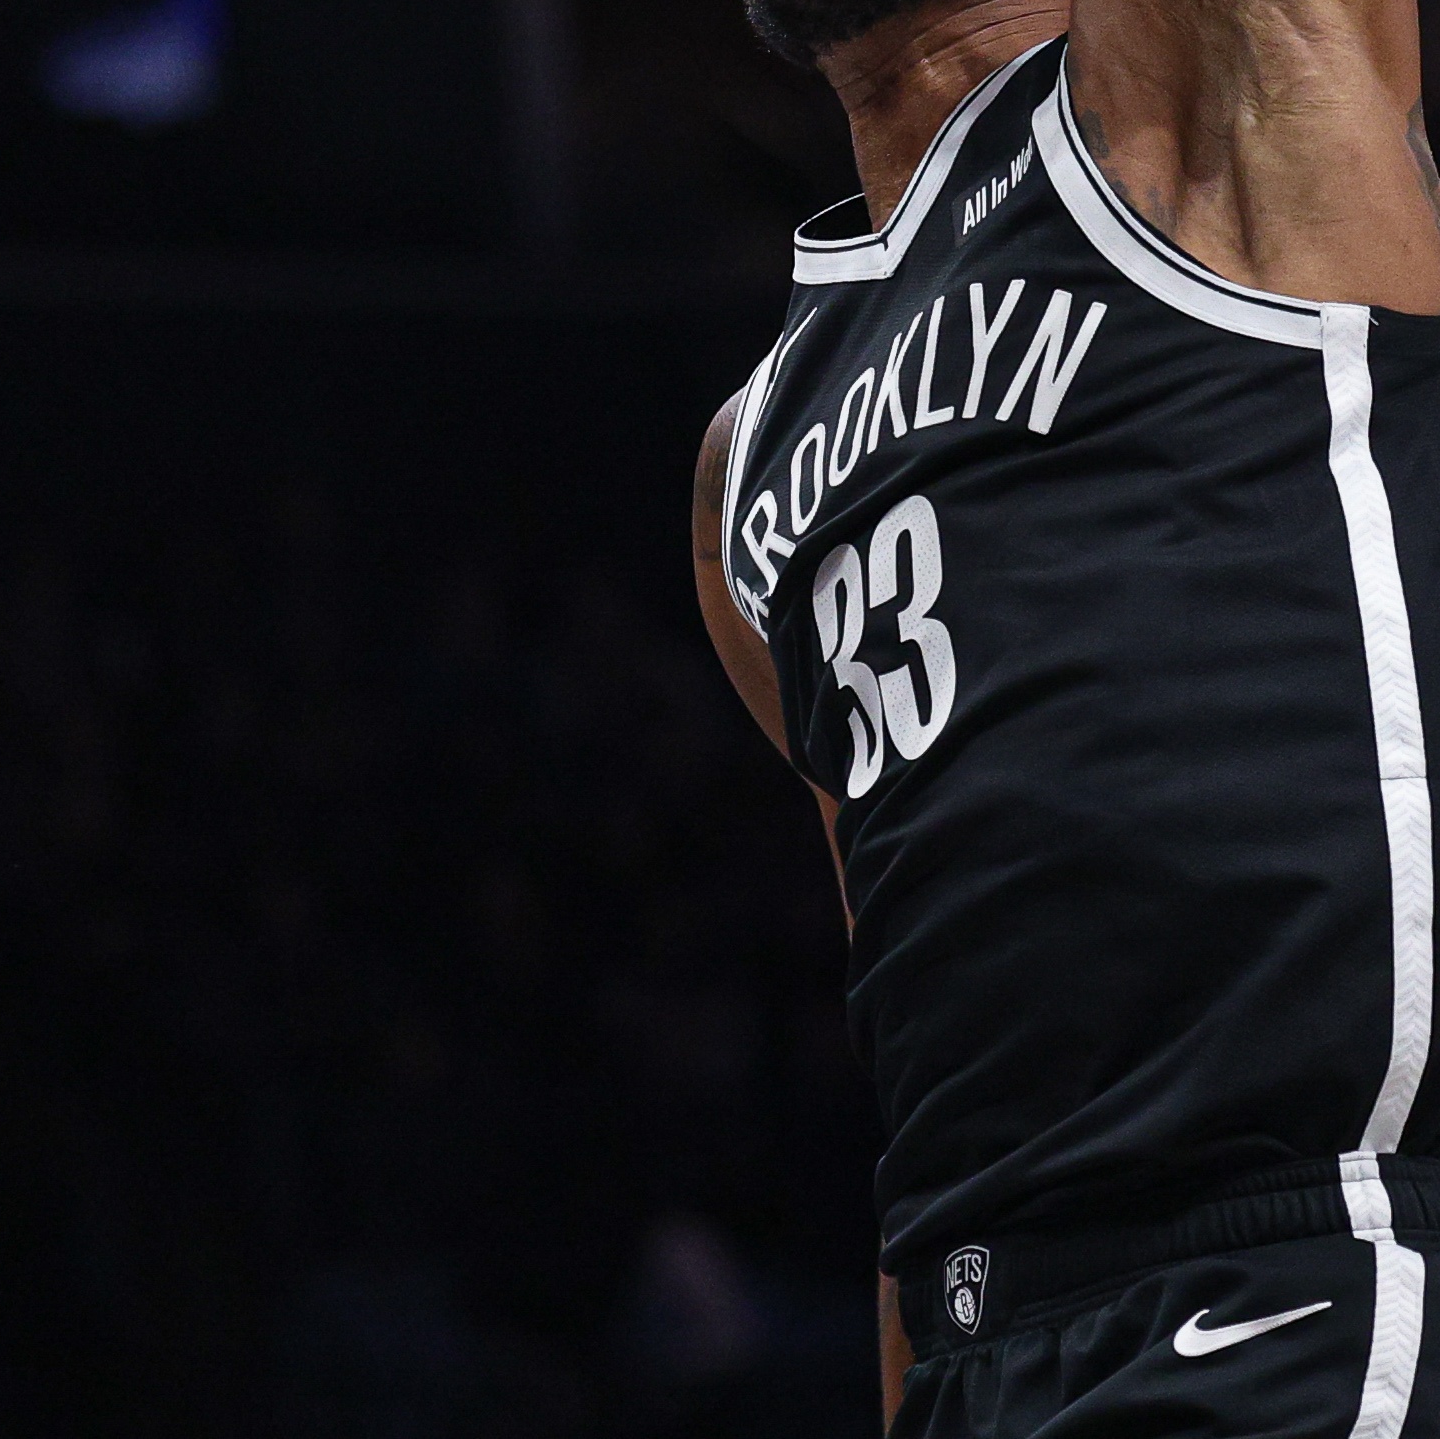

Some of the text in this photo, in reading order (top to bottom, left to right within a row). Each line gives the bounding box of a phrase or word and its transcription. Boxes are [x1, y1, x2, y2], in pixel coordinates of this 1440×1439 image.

[963, 186, 987, 235] All
[992, 177, 1008, 210] In
[813, 495, 956, 799] 33
[946, 1254, 982, 1293] NETS
